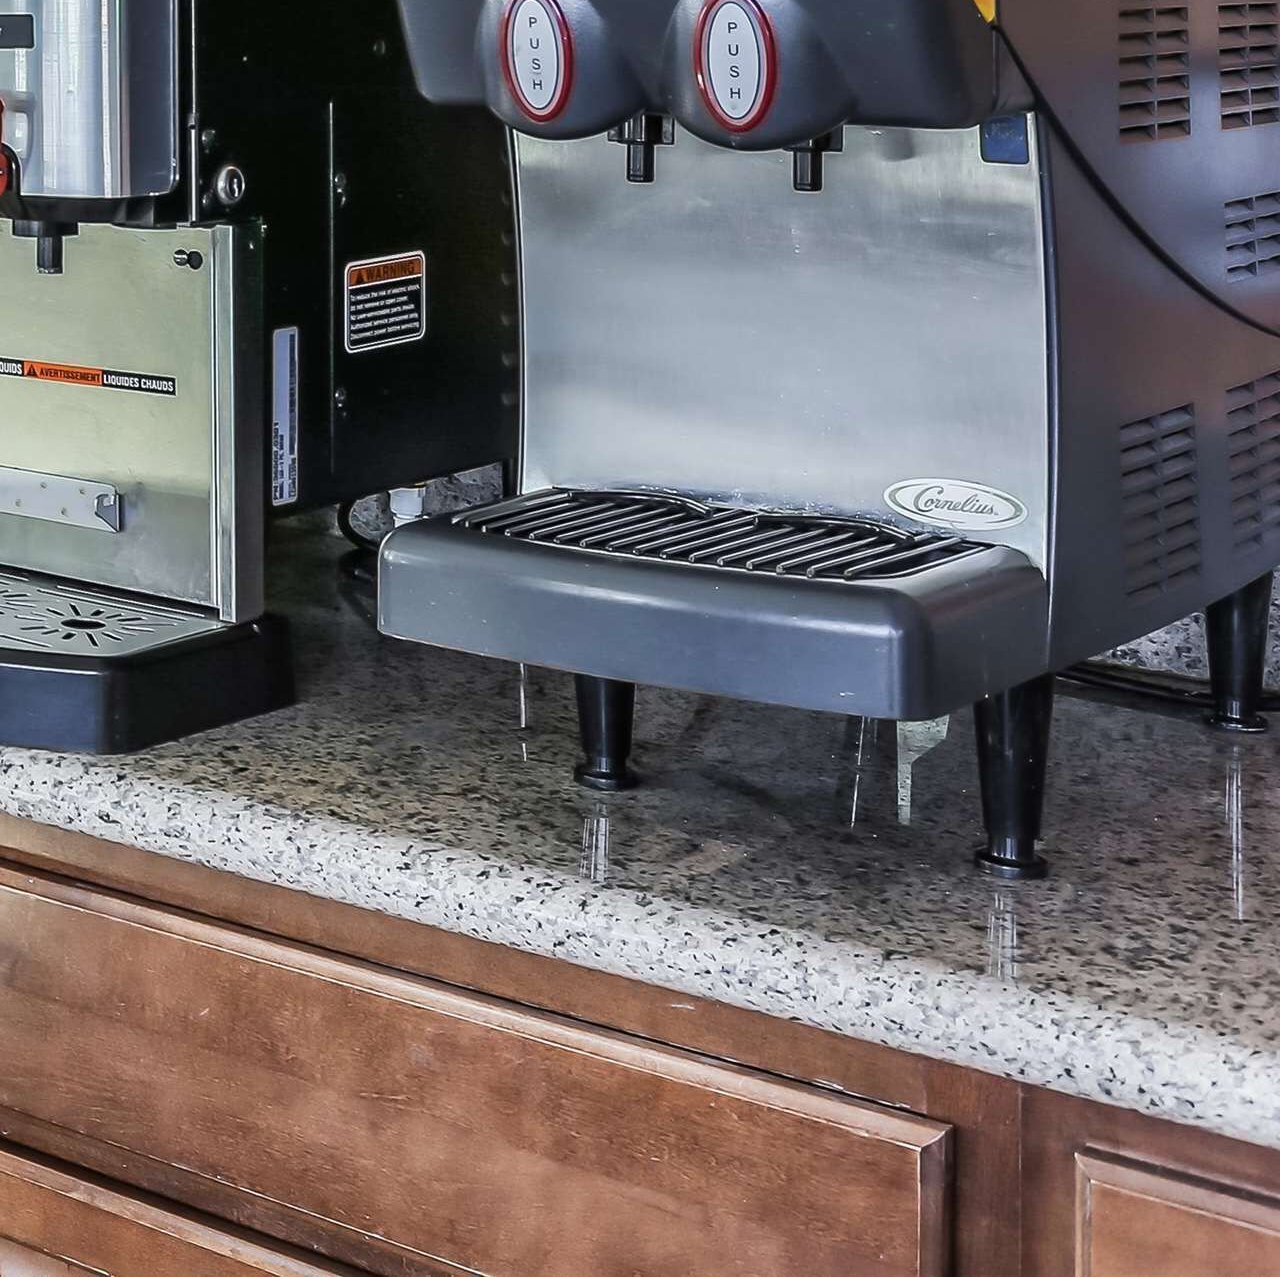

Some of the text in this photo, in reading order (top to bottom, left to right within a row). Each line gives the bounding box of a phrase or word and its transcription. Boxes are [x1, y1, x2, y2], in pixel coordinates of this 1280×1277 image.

[527, 16, 544, 91] PUSH
[726, 21, 743, 100] PUSH
[367, 261, 415, 282] WARNING
[39, 368, 101, 383] AVERTISSEMENT
[103, 374, 140, 388] LIQUIDES
[140, 378, 174, 392] CHAUDS
[913, 485, 995, 516] Cornelius
